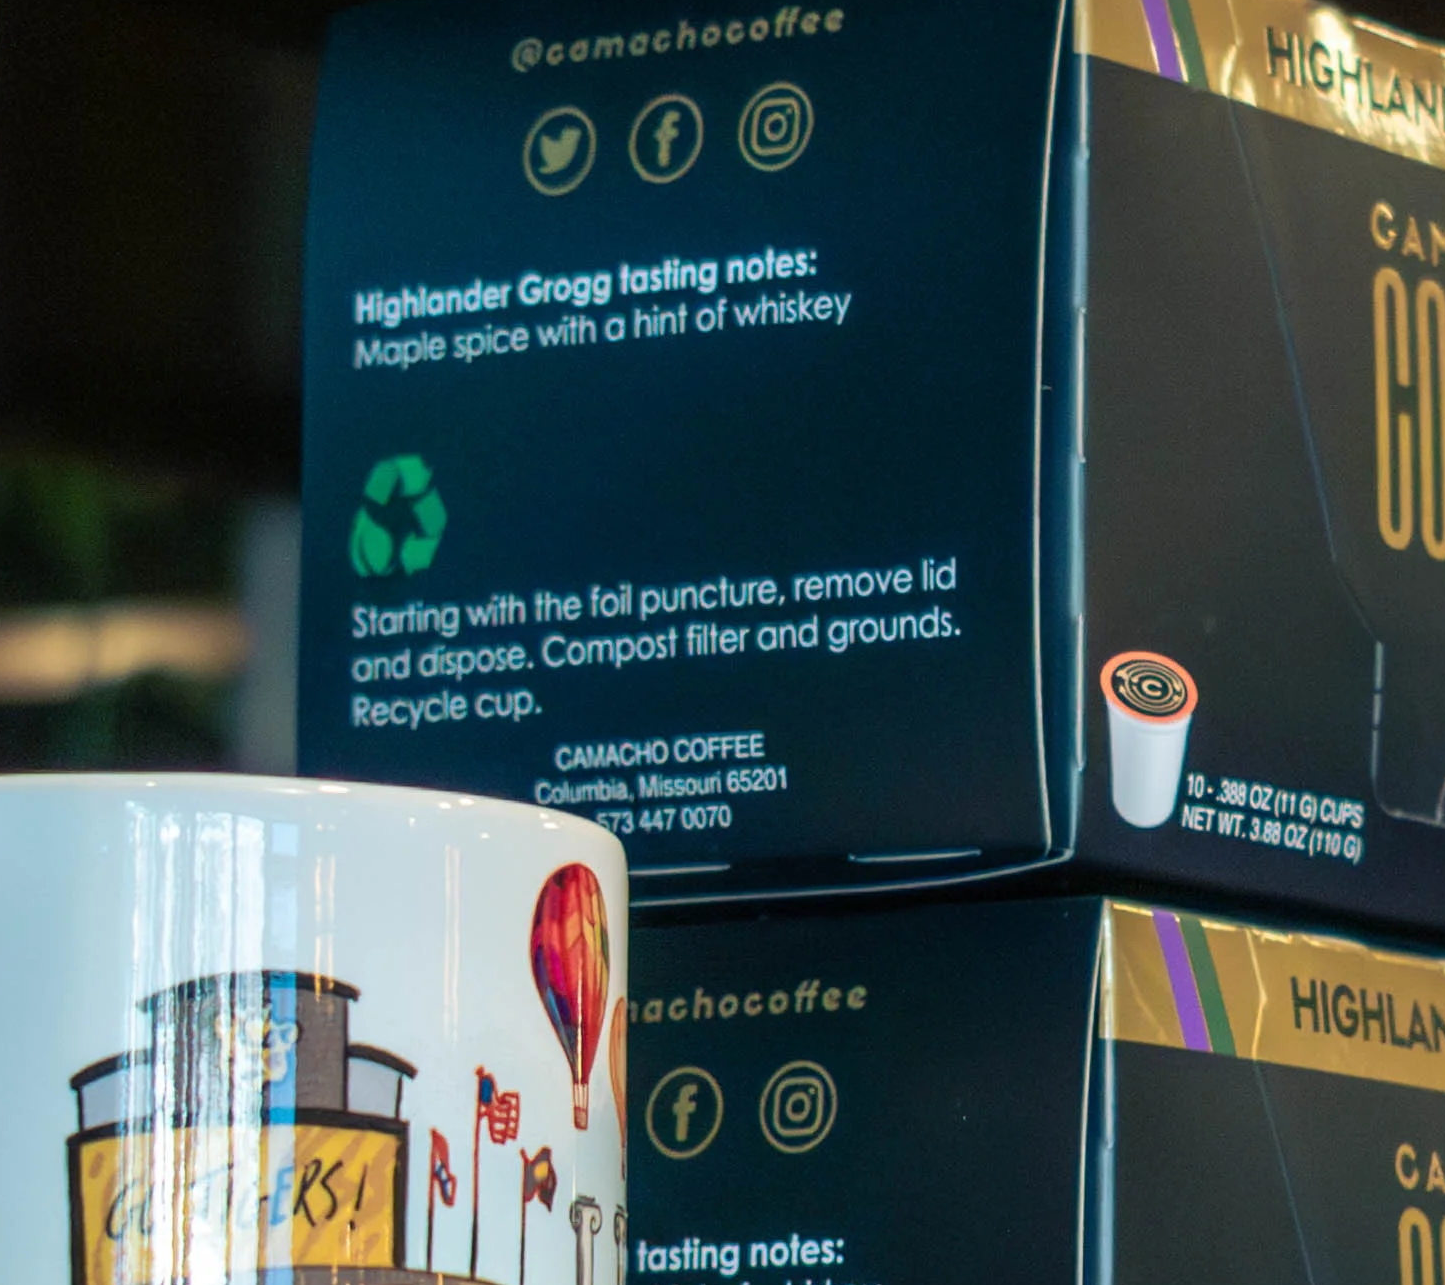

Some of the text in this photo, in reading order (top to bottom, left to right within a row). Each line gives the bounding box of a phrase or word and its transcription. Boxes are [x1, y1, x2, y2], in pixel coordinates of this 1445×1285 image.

[511, 6, 846, 72] @camachocoffee
[355, 247, 817, 328] Highlander Grogg tasting notes:
[355, 291, 851, 370] Maple spice with a hint of whiskey
[353, 556, 956, 638] Starting with the foil puncture, remove lid
[354, 605, 961, 682] and dispose. Compost filter and grounds.
[353, 689, 542, 731] Recycle cup.
[555, 733, 765, 770] CAMACHO COFFEE
[535, 767, 787, 804] Columbia, Missouri 65201
[1187, 773, 1204, 798] 10
[1250, 785, 1273, 811] OZ
[1274, 790, 1295, 817] (11
[1299, 794, 1317, 824] G)
[1320, 798, 1364, 828] CUPS
[639, 808, 676, 832] 447
[681, 805, 731, 830] 0070
[1182, 805, 1217, 831] NET
[1218, 812, 1246, 839] WT.
[1285, 824, 1308, 850] OZ
[1309, 829, 1341, 856] (110
[1344, 835, 1363, 865] G)
[628, 980, 868, 1023] achocoffee
[637, 1233, 845, 1275] tasting notes:
